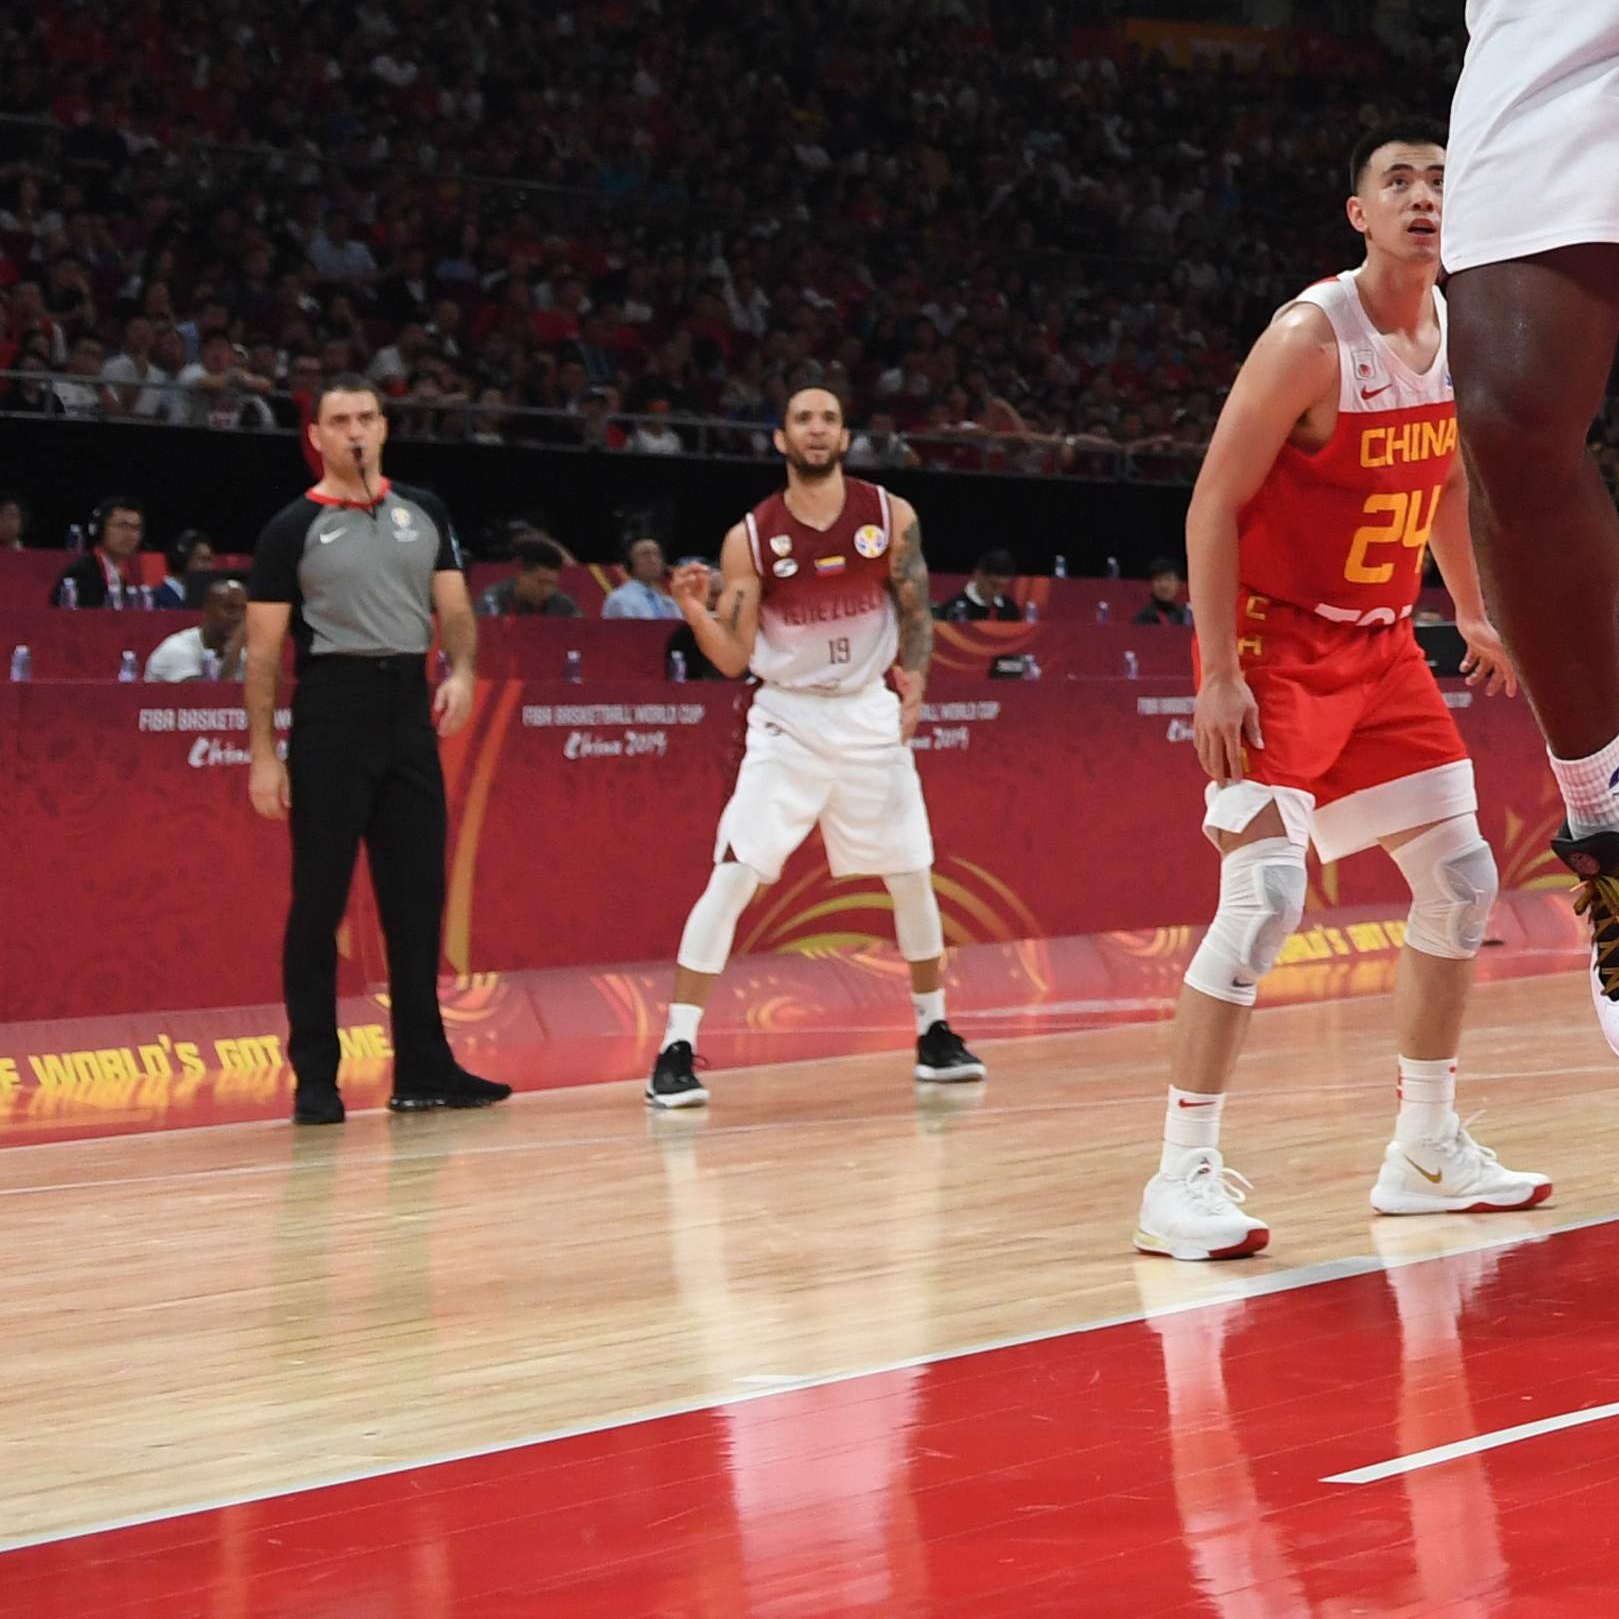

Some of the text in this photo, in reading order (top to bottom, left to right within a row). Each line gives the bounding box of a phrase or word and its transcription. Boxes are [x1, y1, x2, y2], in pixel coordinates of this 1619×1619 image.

[1360, 416, 1458, 469] CHINA
[1344, 484, 1442, 584] 24
[828, 637, 851, 664] 19
[177, 708, 248, 731] BASKETB
[188, 736, 252, 768] Chin
[29, 1033, 207, 1086] WORLD'S
[215, 1035, 284, 1072] GOT
[337, 1024, 394, 1060] ME
